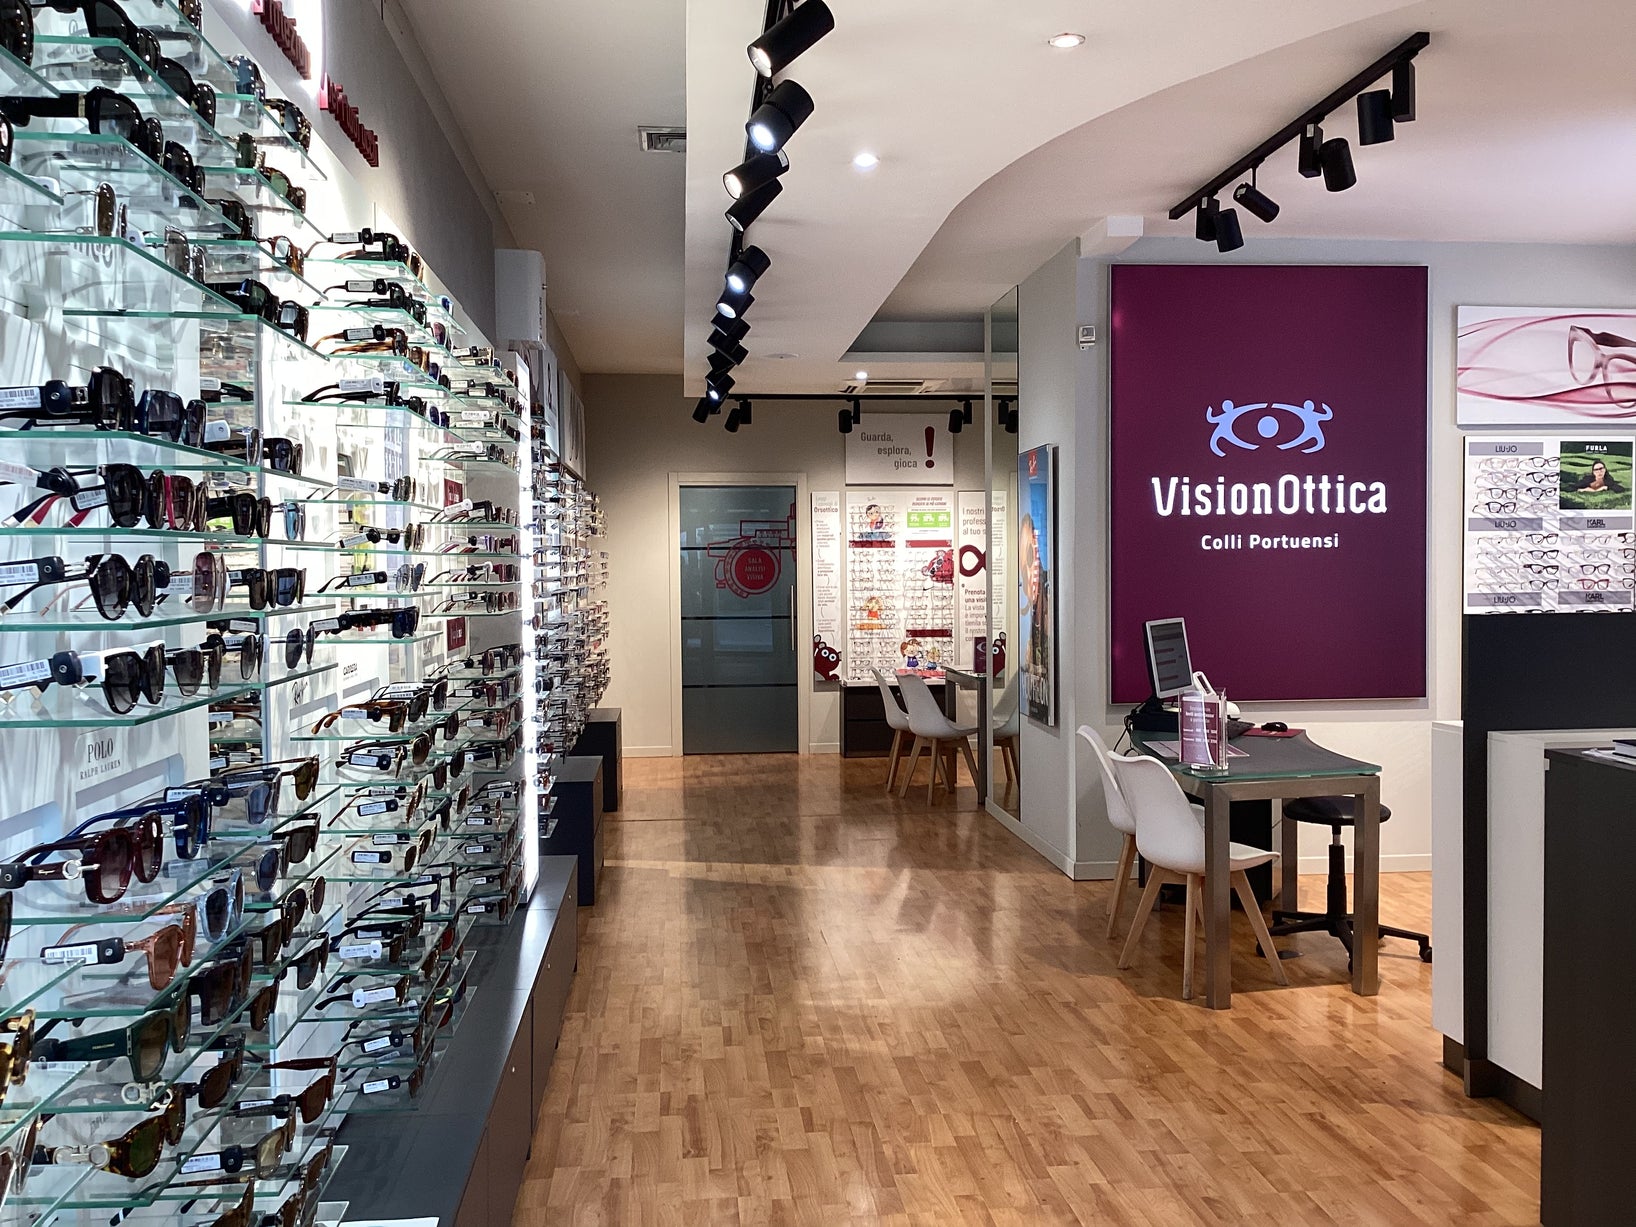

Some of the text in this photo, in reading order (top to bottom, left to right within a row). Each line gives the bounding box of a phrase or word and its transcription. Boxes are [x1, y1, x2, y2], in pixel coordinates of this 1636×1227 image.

[860, 432, 894, 442] Guarda,
[877, 445, 912, 457] esplora,
[894, 459, 918, 470] gioca
[1151, 474, 1388, 517] VisionOttica
[966, 507, 985, 515] nostri
[1201, 533, 1340, 550] Colli Portuensi
[87, 737, 114, 763] POLO
[80, 759, 121, 780] RALPH LAUREN
